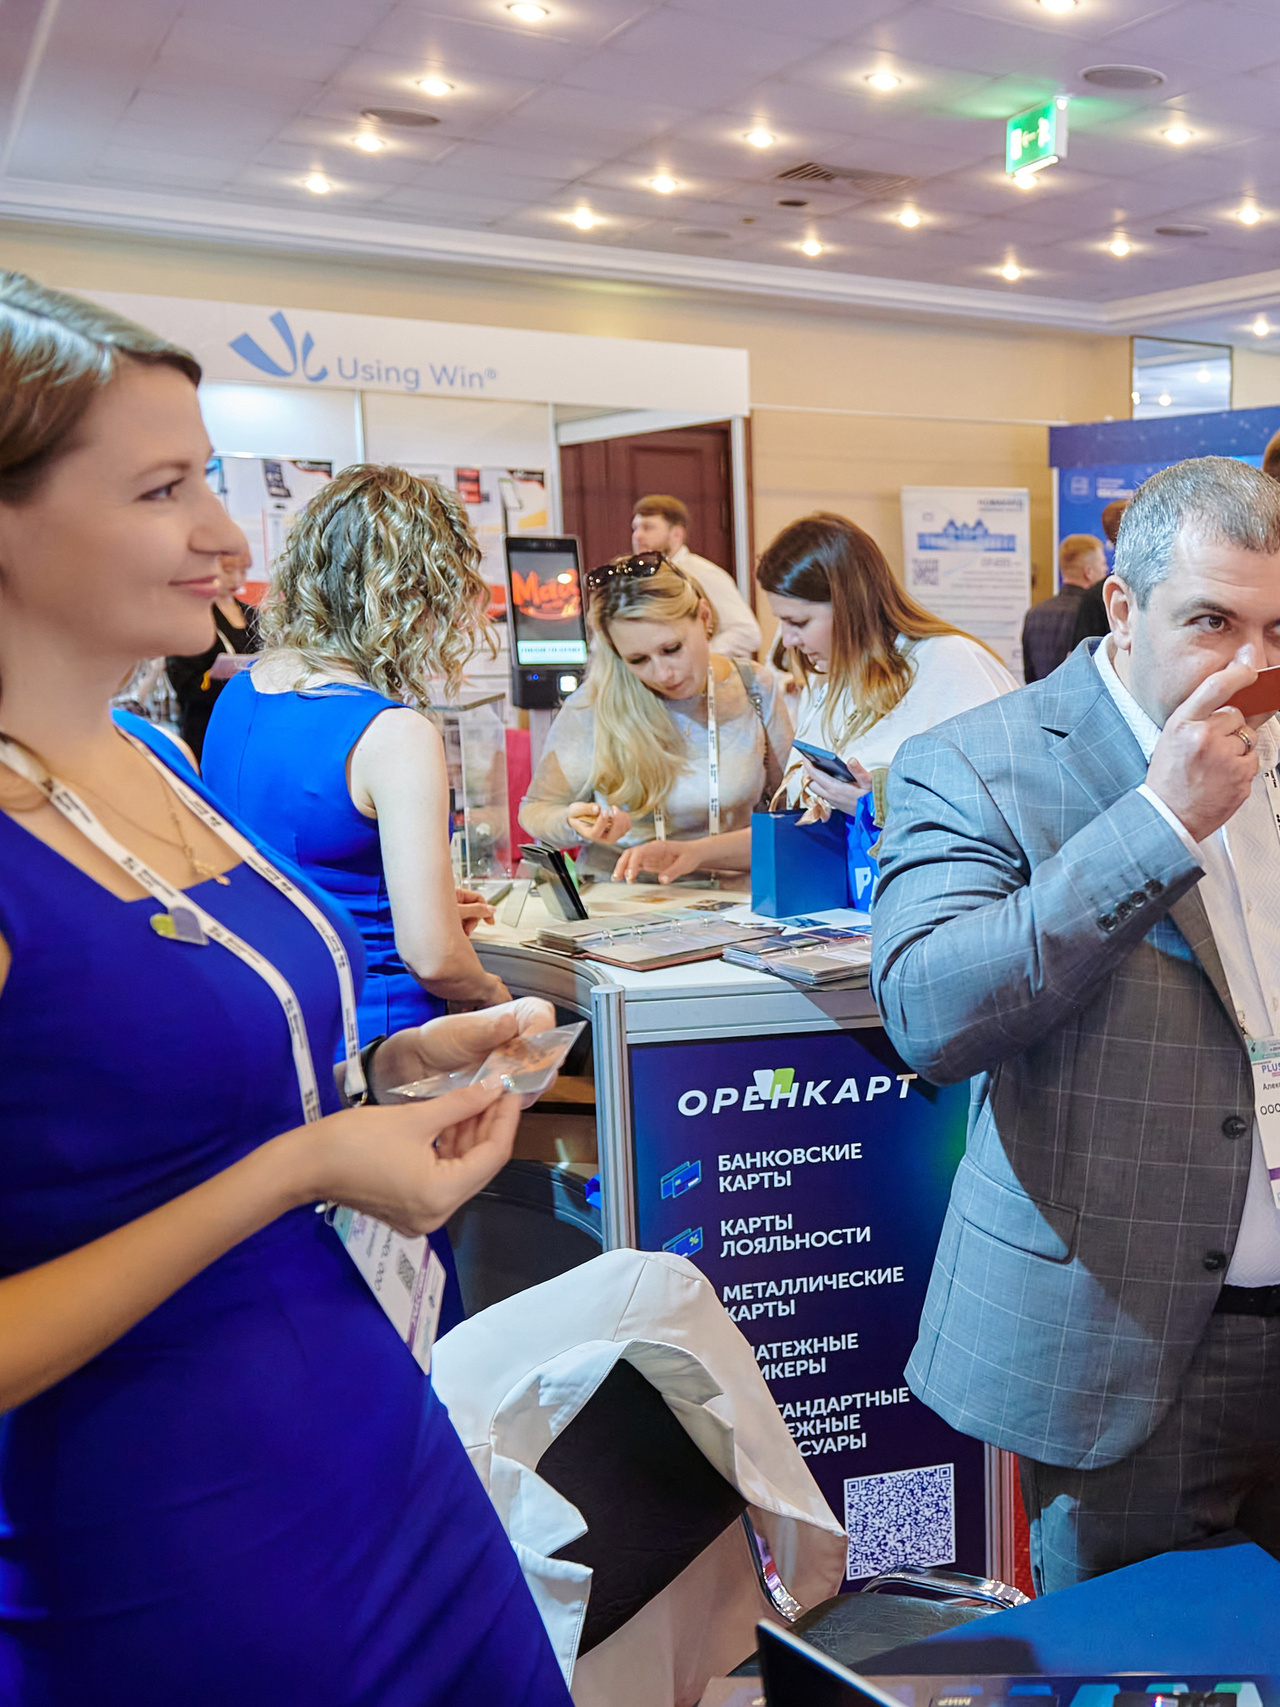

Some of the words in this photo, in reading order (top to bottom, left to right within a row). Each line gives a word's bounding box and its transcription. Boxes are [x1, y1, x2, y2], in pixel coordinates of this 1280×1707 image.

[337, 356, 421, 392] Using
[677, 1073, 918, 1117] ОРЕНКАРТ
[718, 1142, 863, 1172] БАНКОВСКИЕ
[718, 1170, 792, 1193] КАРТЫ
[720, 1213, 794, 1237] КАРТЫ
[720, 1226, 872, 1258] ЛОЯЛЬНОСТИ
[723, 1266, 904, 1302] МЕТАЛЛИЧЕСКИЕ
[724, 1299, 796, 1322] КАРТЫ
[752, 1332, 859, 1361] АТЕЖНЫЕ
[760, 1356, 827, 1380] ИКЕРЫ
[785, 1413, 861, 1438] ЕЖНЫЕ
[797, 1432, 867, 1457] СУАРЫ
